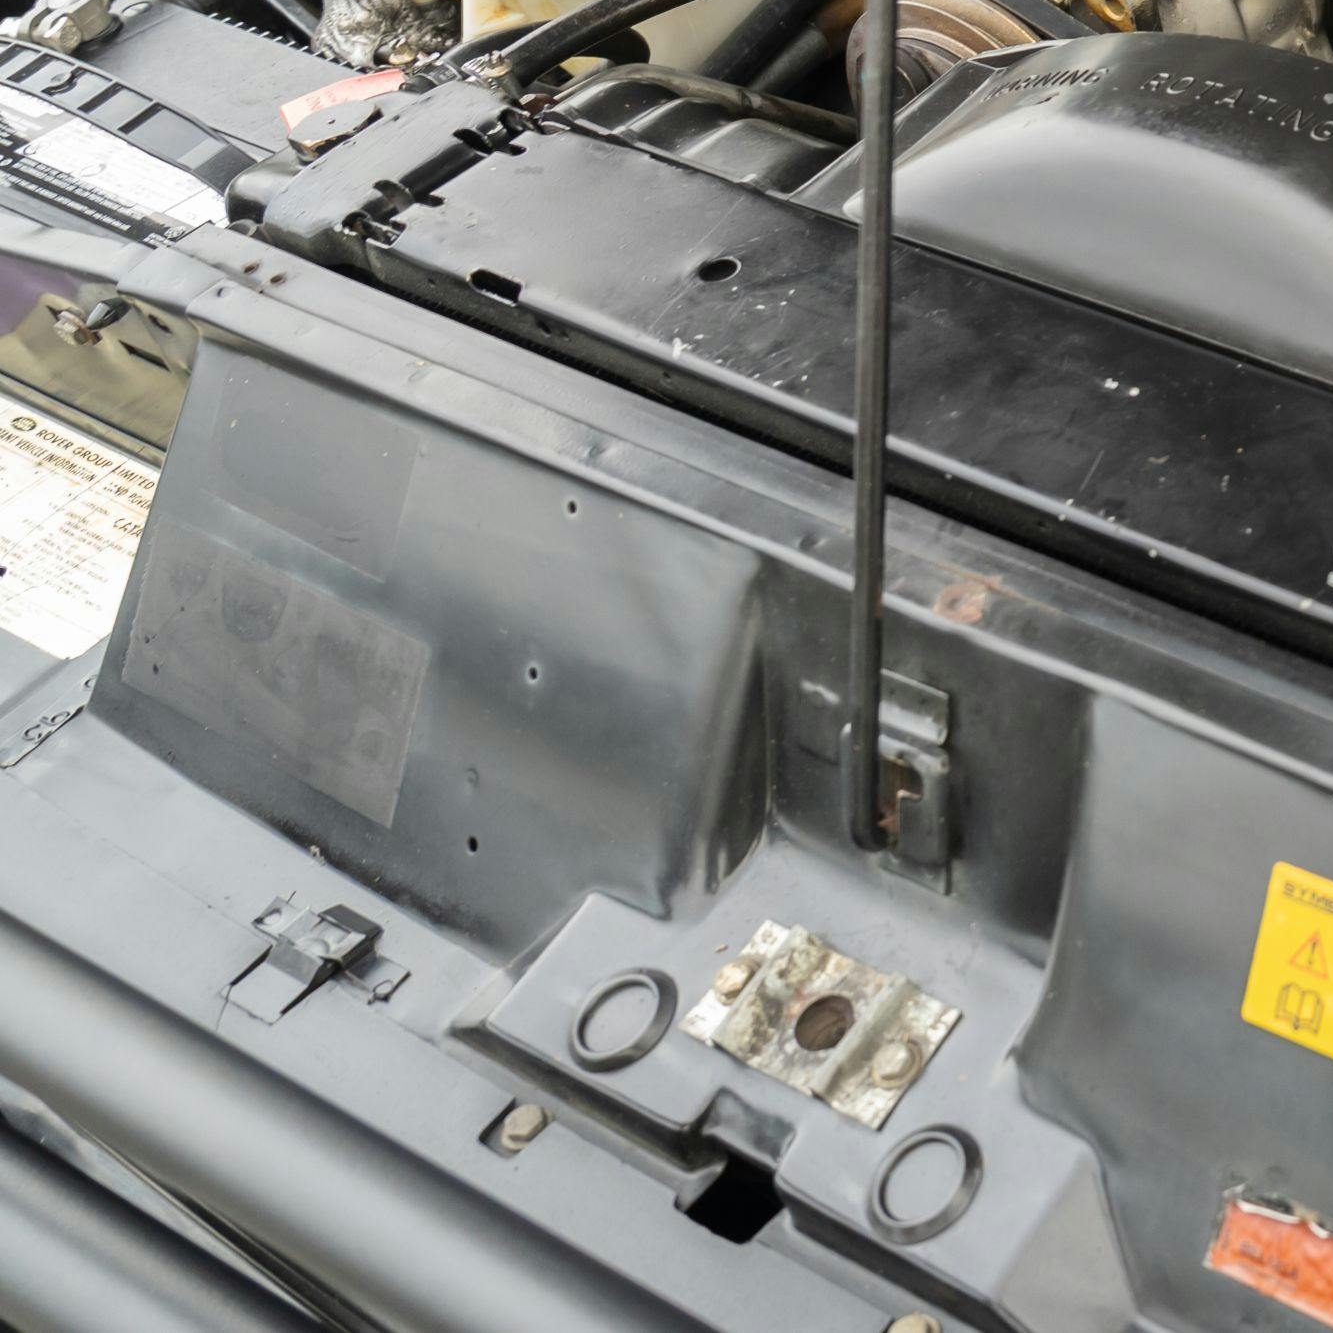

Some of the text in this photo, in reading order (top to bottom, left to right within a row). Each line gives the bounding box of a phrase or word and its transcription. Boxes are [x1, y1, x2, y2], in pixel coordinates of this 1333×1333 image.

[983, 68, 1109, 102] WARNING
[16, 438, 48, 459] VEHICLE
[42, 453, 98, 483] INFORMATION
[35, 428, 156, 490] ROVER GROUP LIMITED
